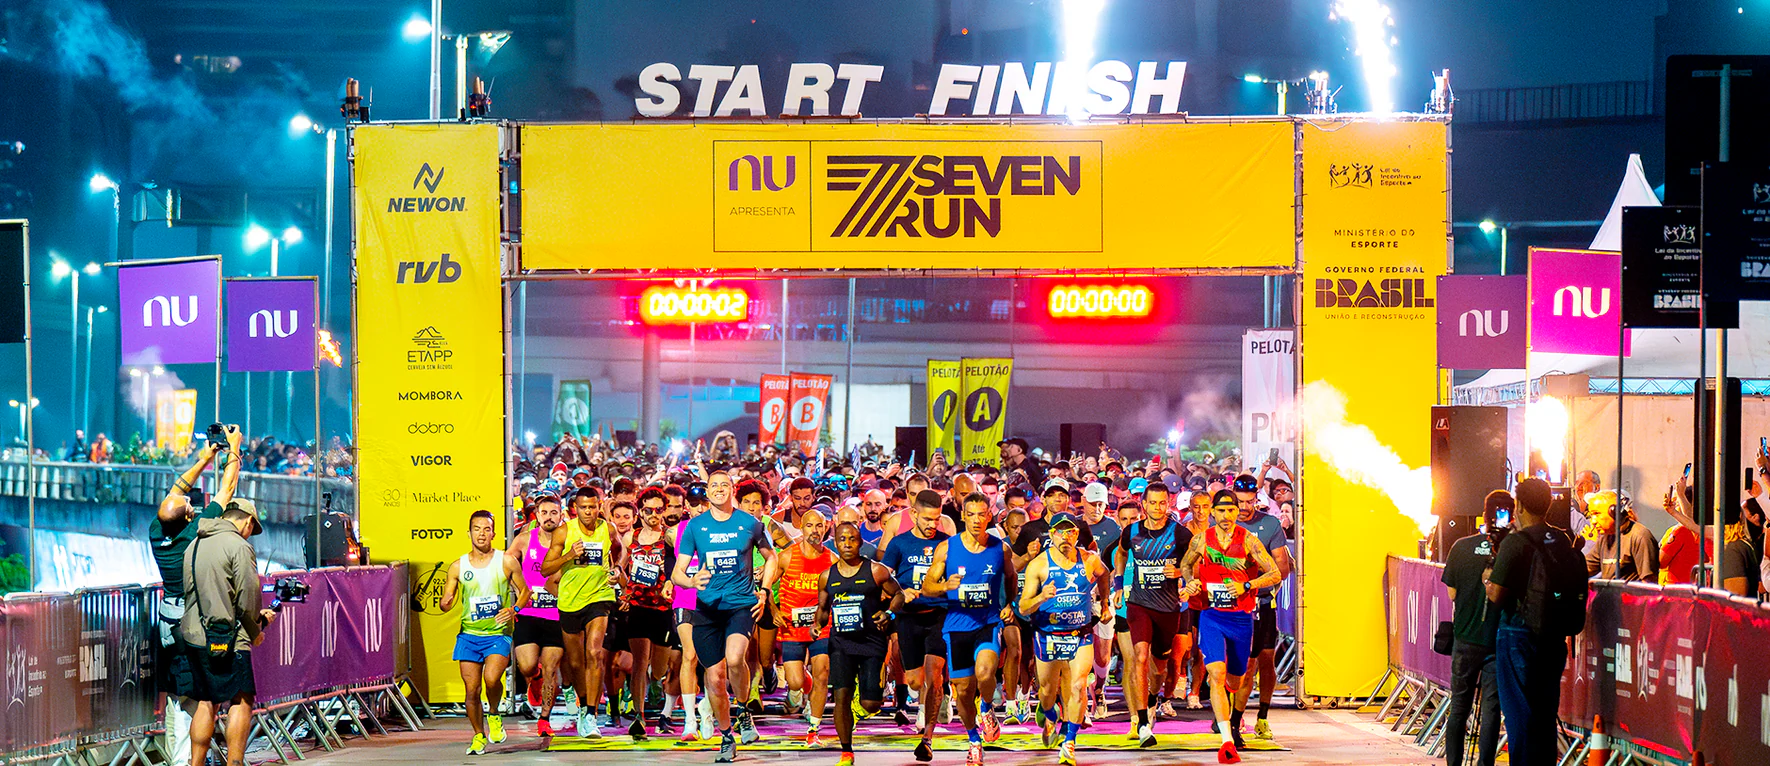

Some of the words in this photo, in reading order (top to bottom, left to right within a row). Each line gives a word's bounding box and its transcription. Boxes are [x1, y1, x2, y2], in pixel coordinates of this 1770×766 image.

[635, 62, 884, 117] START
[929, 60, 1188, 115] FINISH
[729, 154, 796, 192] nu
[913, 154, 1081, 197] SEVEN
[387, 197, 466, 213] NEWON
[729, 206, 796, 216] APRESENTA
[887, 198, 1000, 238] RUN
[1334, 228, 1397, 237] MINISTÉRIO
[1401, 229, 1416, 237] DO
[1351, 241, 1399, 249] ESPORTE
[396, 253, 462, 284] rvb
[1315, 278, 1435, 308] BRASIL
[650, 293, 745, 317] 00:00:02
[1051, 289, 1147, 313] 00:00:00
[1553, 285, 1611, 318] nu
[143, 295, 198, 327] nu
[1360, 313, 1426, 321] RECONSTRUÇÃO
[249, 309, 298, 337] nu
[1459, 308, 1509, 338] nu
[407, 350, 453, 362] ETAPP
[965, 364, 1009, 376] PELOTÃO
[792, 378, 829, 390] PELOTÃO
[398, 390, 463, 401] MOMBORA
[801, 402, 814, 424] B
[972, 392, 991, 422] A
[770, 404, 780, 424] B
[408, 422, 454, 434] dobro
[410, 455, 452, 466] VIGOR
[382, 488, 400, 502] 30
[412, 492, 448, 502] Market
[452, 492, 481, 502] Place
[411, 528, 454, 540] FOTOP
[631, 554, 662, 563] KENYA
[716, 558, 737, 566] 6421
[800, 572, 820, 580] EQUIP
[540, 593, 558, 601] 639
[968, 592, 988, 600] 7241
[839, 615, 860, 623] 6593
[1056, 611, 1086, 621] POSTAL
